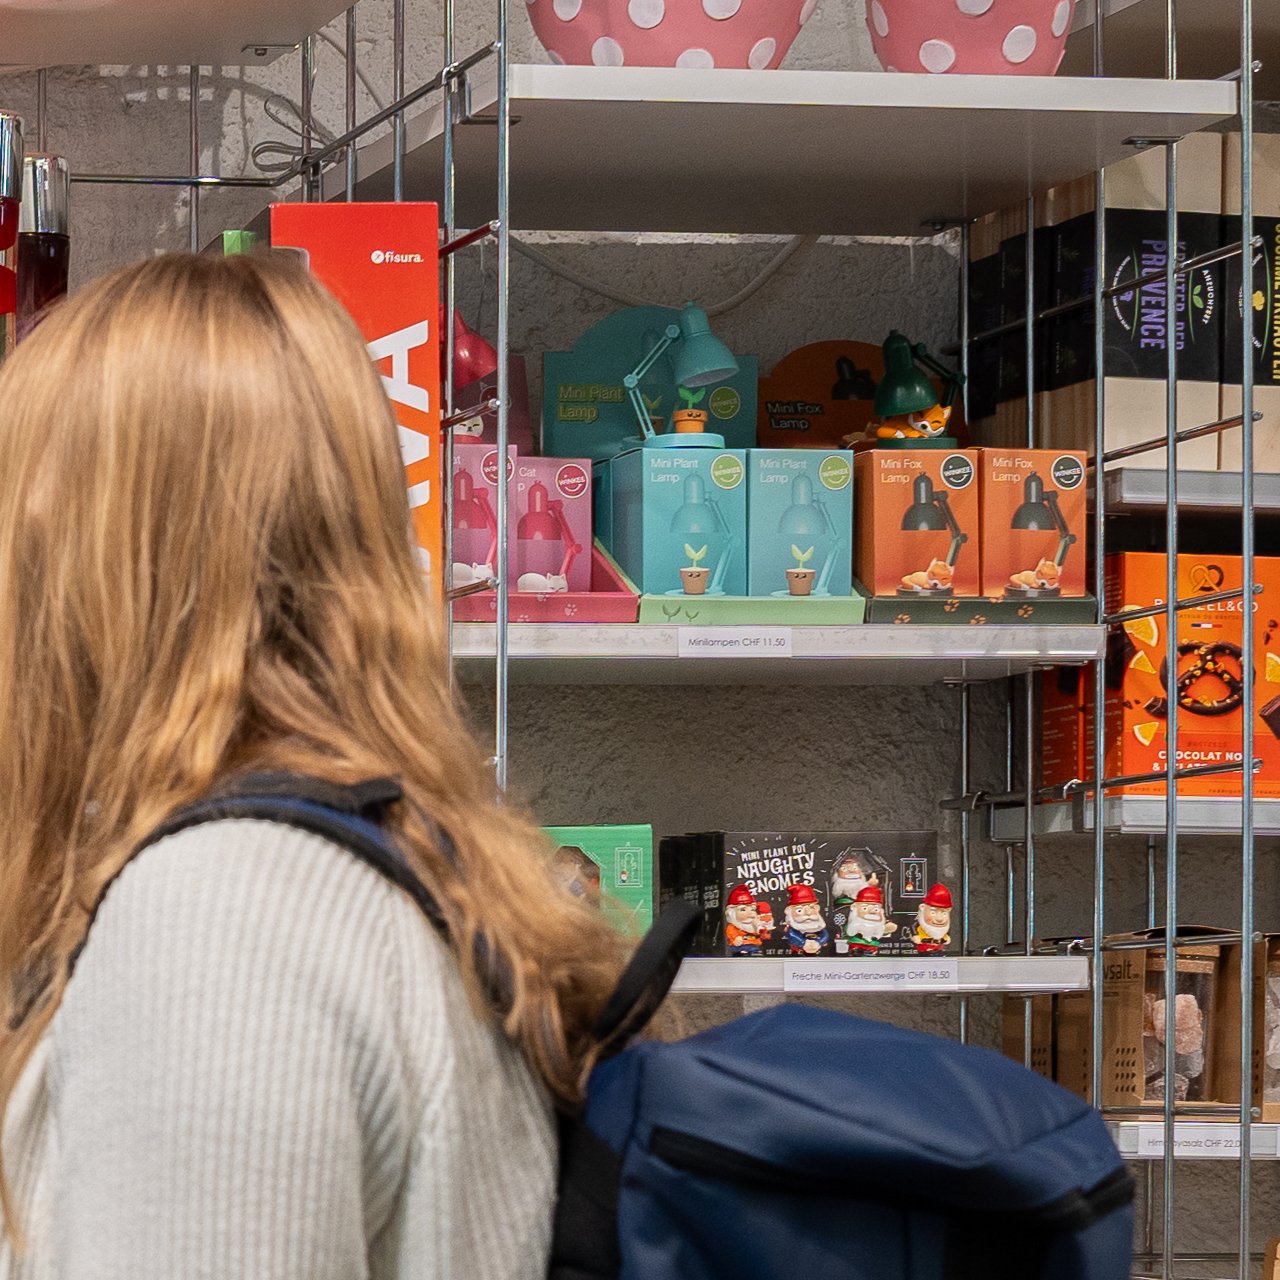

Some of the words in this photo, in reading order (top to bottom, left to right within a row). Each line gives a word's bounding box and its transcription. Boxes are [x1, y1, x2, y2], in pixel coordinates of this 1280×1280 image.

[767, 402, 794, 414] Mini
[797, 403, 822, 414] Fox
[559, 407, 597, 422] Lamp
[771, 417, 808, 430] Lamp
[651, 472, 680, 484] Lamp
[760, 473, 788, 484] Lamp
[881, 473, 910, 484] Lamp
[992, 472, 1021, 483] Lamp
[688, 638, 739, 648] Minilampen
[742, 638, 760, 647] CHF
[763, 638, 785, 647] 11.50
[741, 851, 761, 862] MINI
[763, 846, 789, 859] PLANT
[792, 843, 807, 855] POT
[736, 851, 816, 880] NAUGHTY
[744, 871, 815, 896] GNOMES
[792, 972, 821, 981] Freche
[824, 971, 905, 981] Mini-Gartenzwerge
[908, 971, 925, 979] CHF
[928, 970, 950, 979] 18.50
